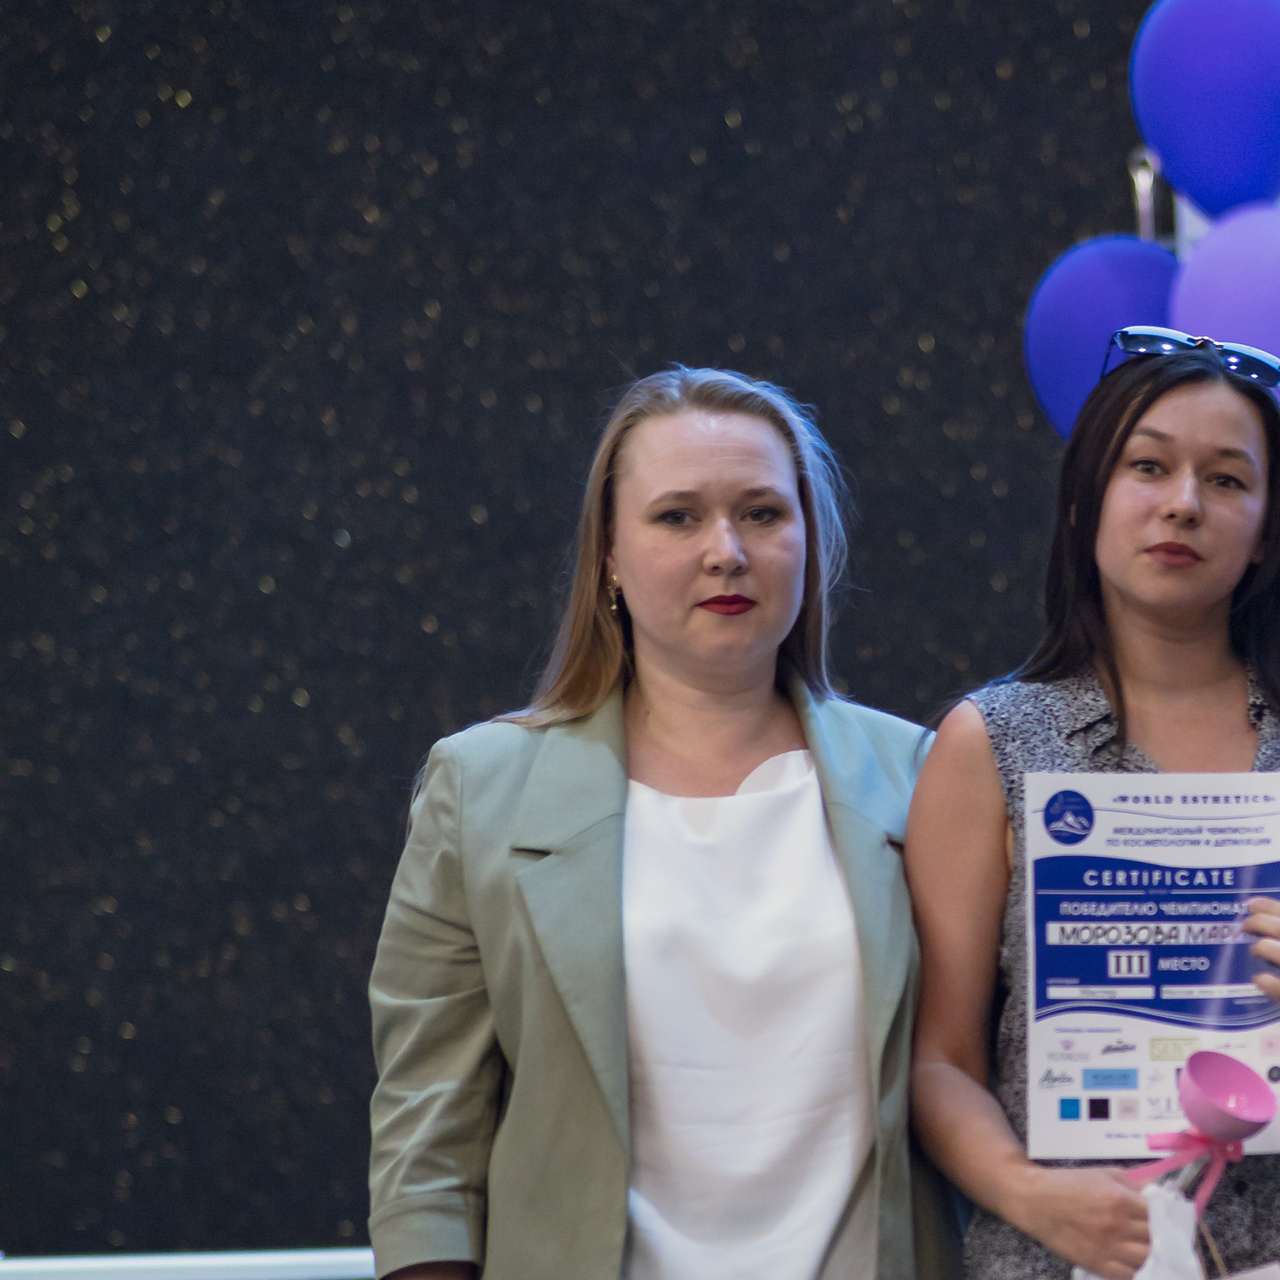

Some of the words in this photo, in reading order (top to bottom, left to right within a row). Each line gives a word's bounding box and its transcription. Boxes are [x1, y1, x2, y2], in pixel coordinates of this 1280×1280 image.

[1083, 869, 1235, 886] CERTIFICATE
[1059, 901, 1158, 916] ПОБЕДИТЕЛЮ
[1059, 926, 1180, 944] МОРОЗОВА
[1114, 956, 1145, 974] III
[1158, 957, 1210, 971] МЕСТО
